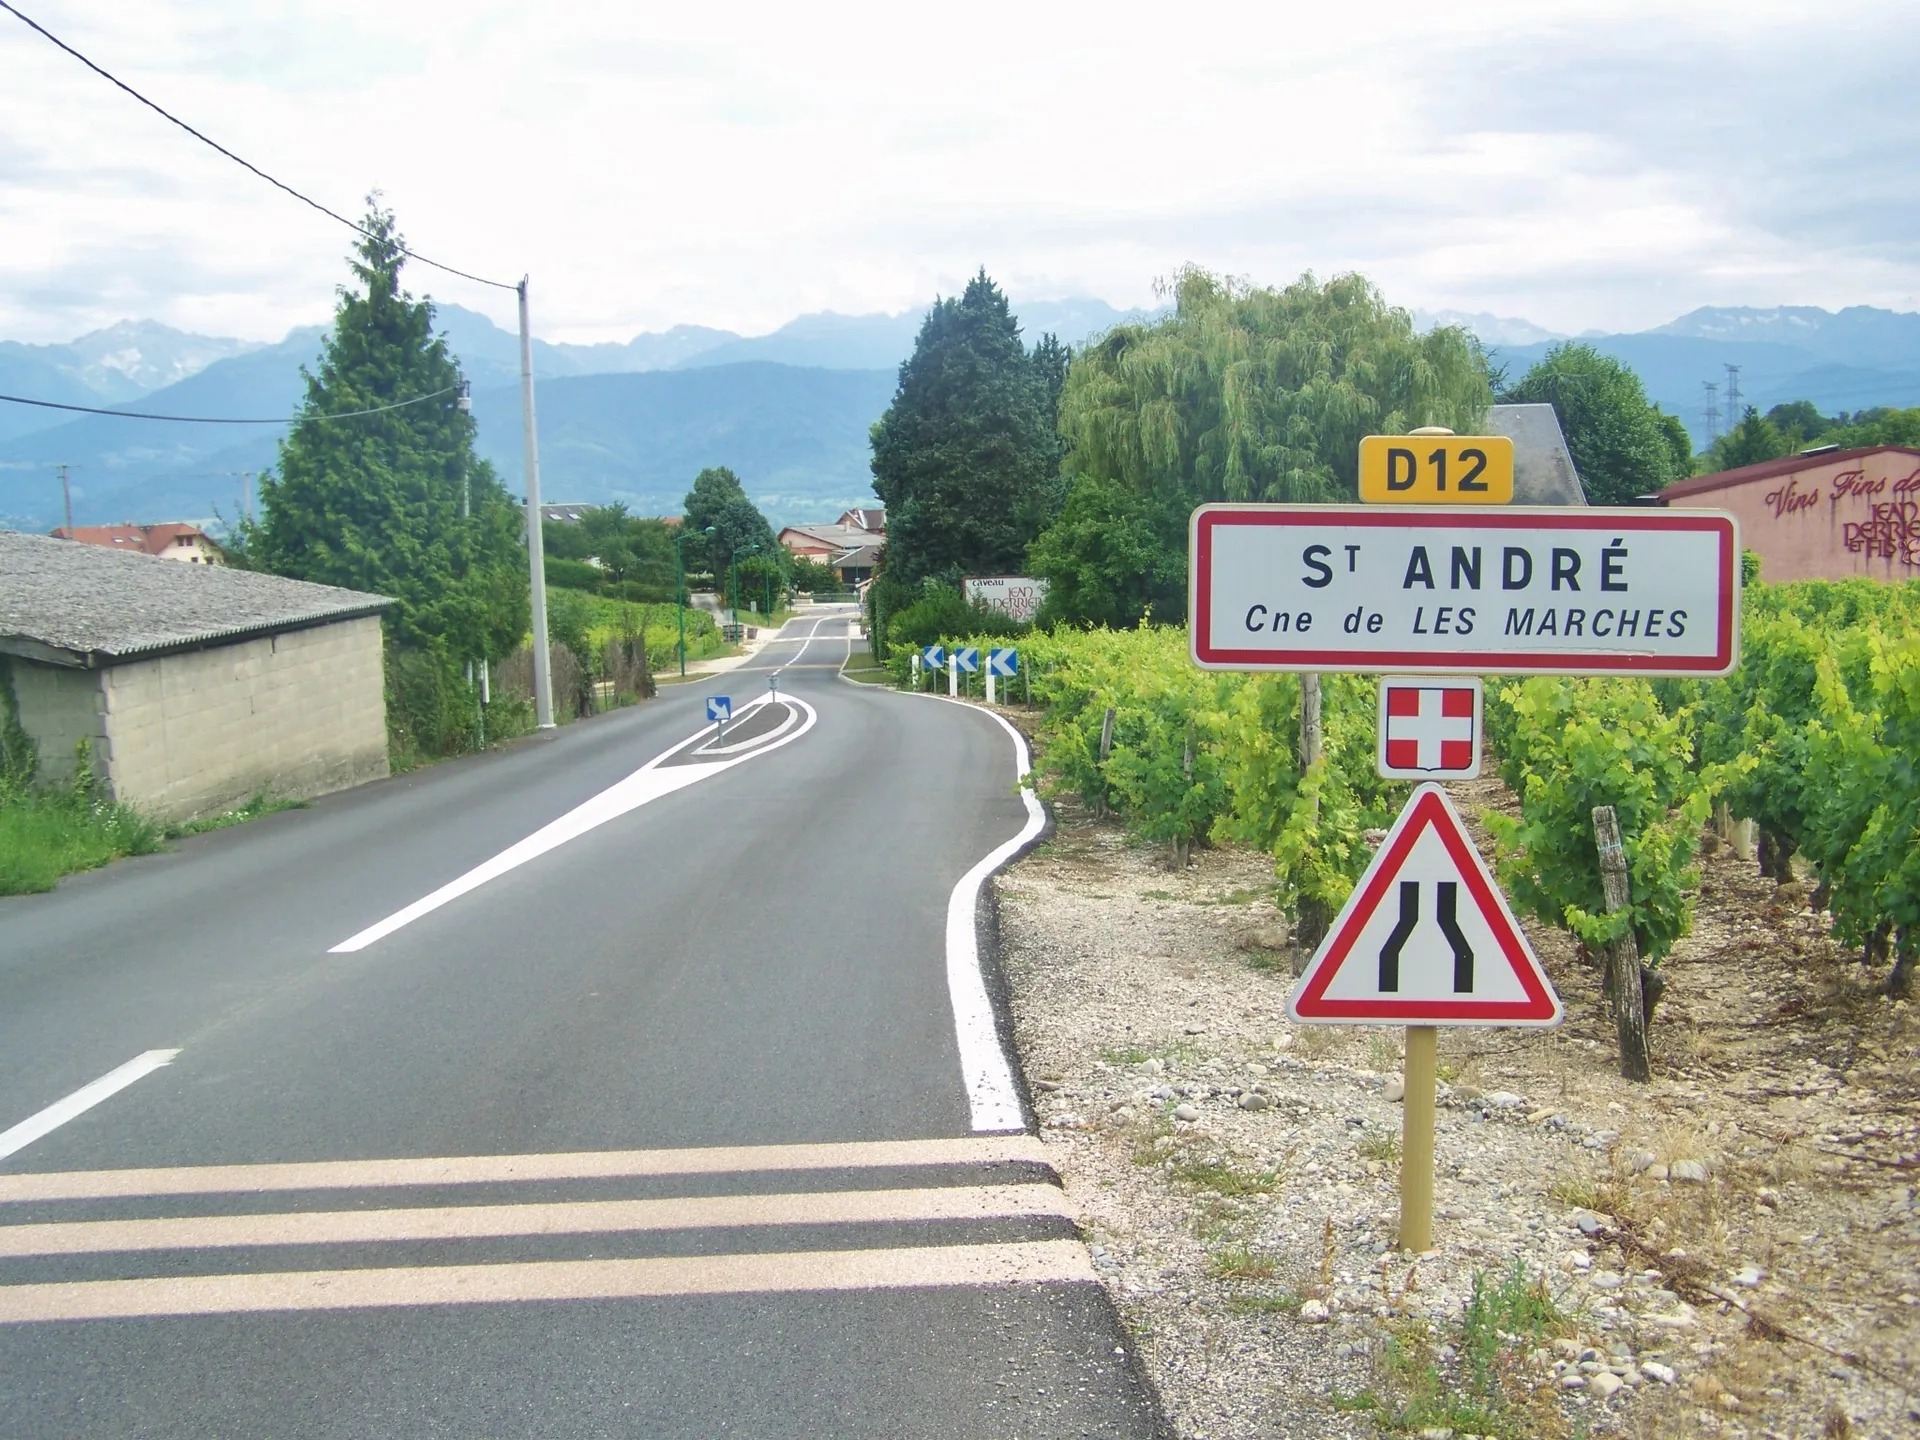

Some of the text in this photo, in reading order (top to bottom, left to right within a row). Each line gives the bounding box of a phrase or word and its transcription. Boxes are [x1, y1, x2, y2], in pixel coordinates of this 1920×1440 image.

[1387, 448, 1488, 492] D12
[1765, 481, 1819, 519] Vins
[1829, 469, 1887, 500] Fins
[1871, 501, 1918, 522] JEAN
[972, 579, 1004, 587] caveau
[1402, 537, 1629, 592] ANDRÉ
[1245, 604, 1688, 638] Cne de LES MARCHES
